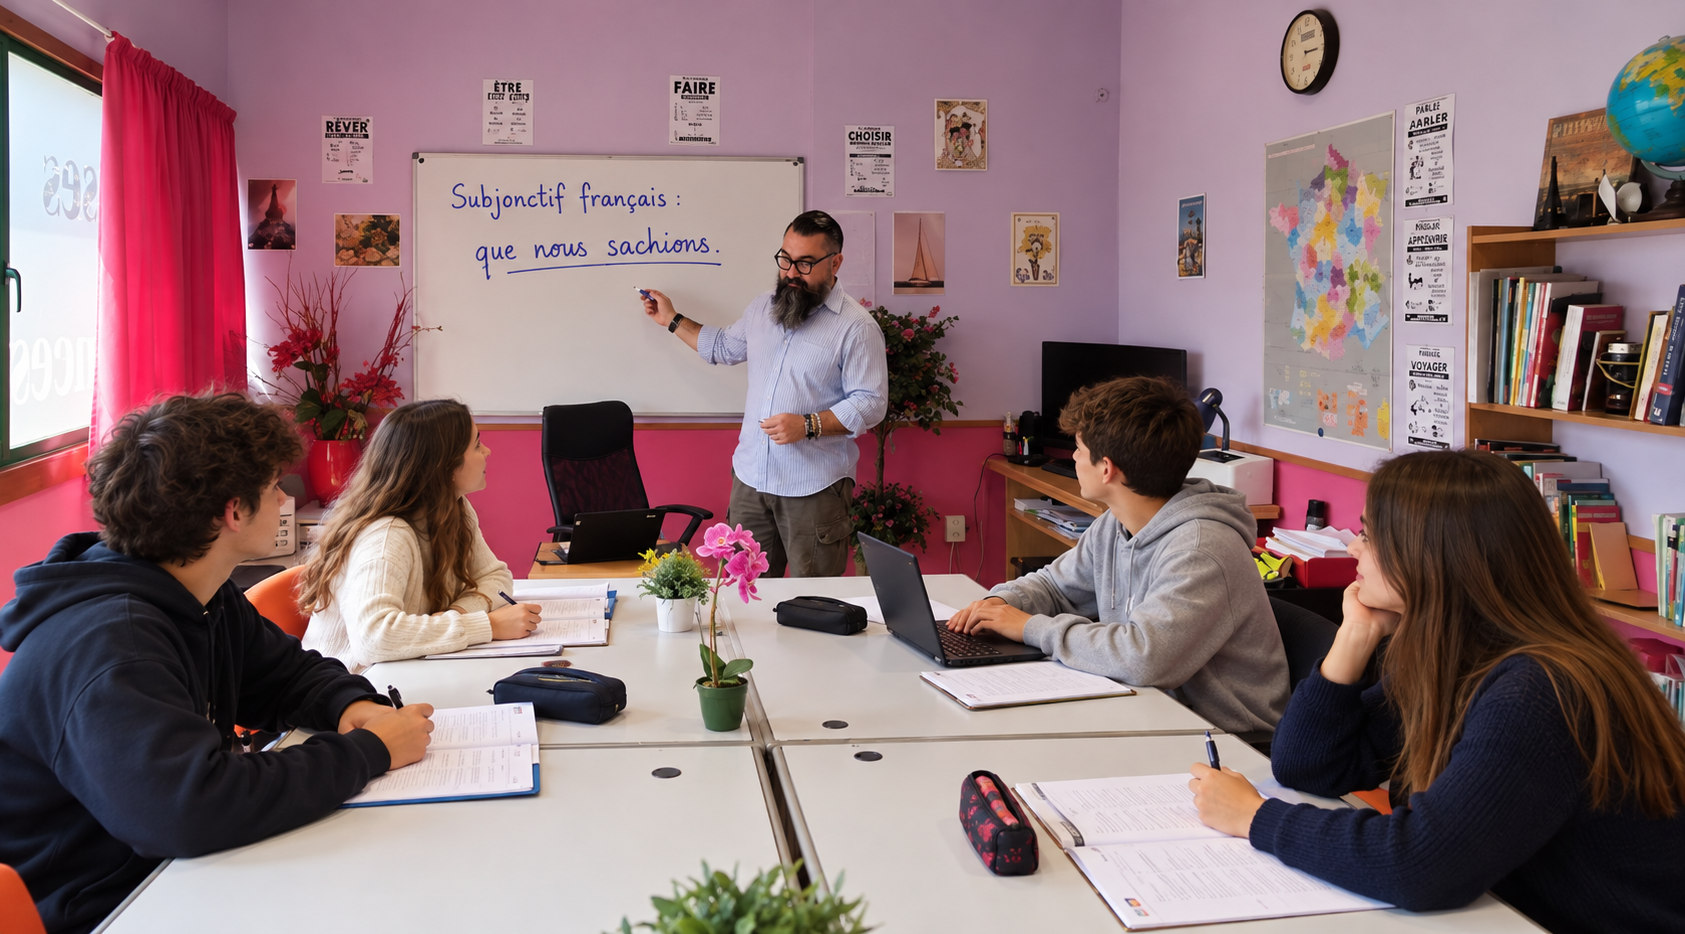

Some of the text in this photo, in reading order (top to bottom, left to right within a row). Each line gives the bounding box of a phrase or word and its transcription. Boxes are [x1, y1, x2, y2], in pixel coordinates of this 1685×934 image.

[674, 81, 715, 94] FAIRE
[848, 131, 891, 141] CHOISIR
[451, 181, 566, 220] Subjonctif
[579, 181, 667, 214] français
[475, 226, 720, 280] que nous sachions.
[1411, 361, 1447, 372] VOYAGER
